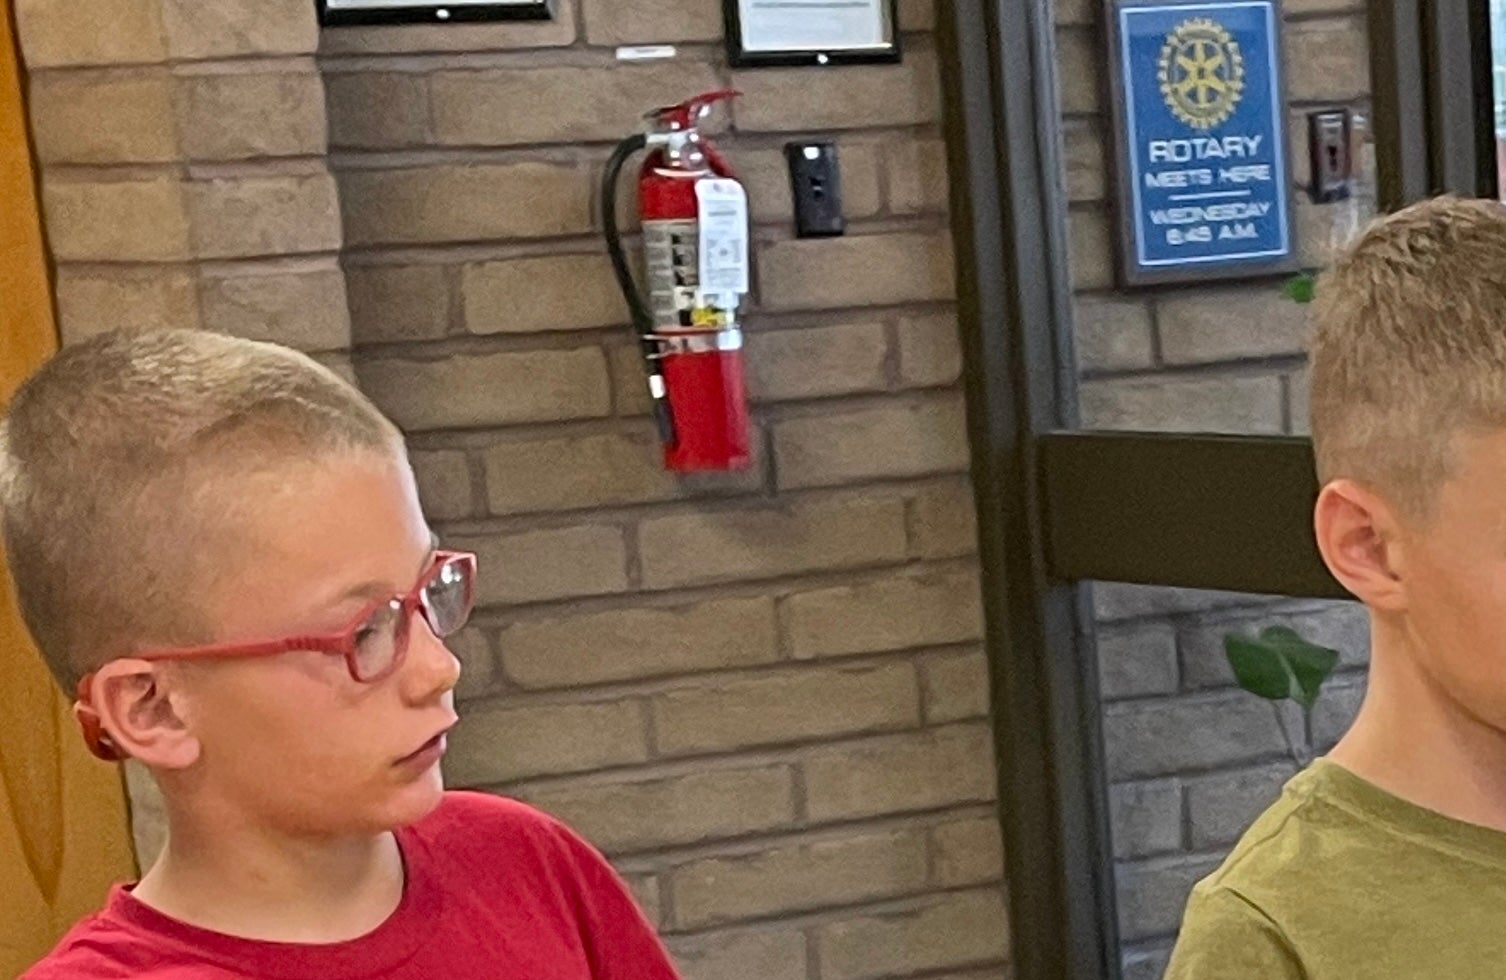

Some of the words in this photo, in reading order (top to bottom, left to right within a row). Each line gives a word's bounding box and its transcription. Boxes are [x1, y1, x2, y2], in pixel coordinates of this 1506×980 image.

[1149, 135, 1263, 163] ROTARY
[1145, 168, 1213, 187] MEETS
[1218, 164, 1271, 183] HERE
[1150, 202, 1270, 225] WEDNESDAY
